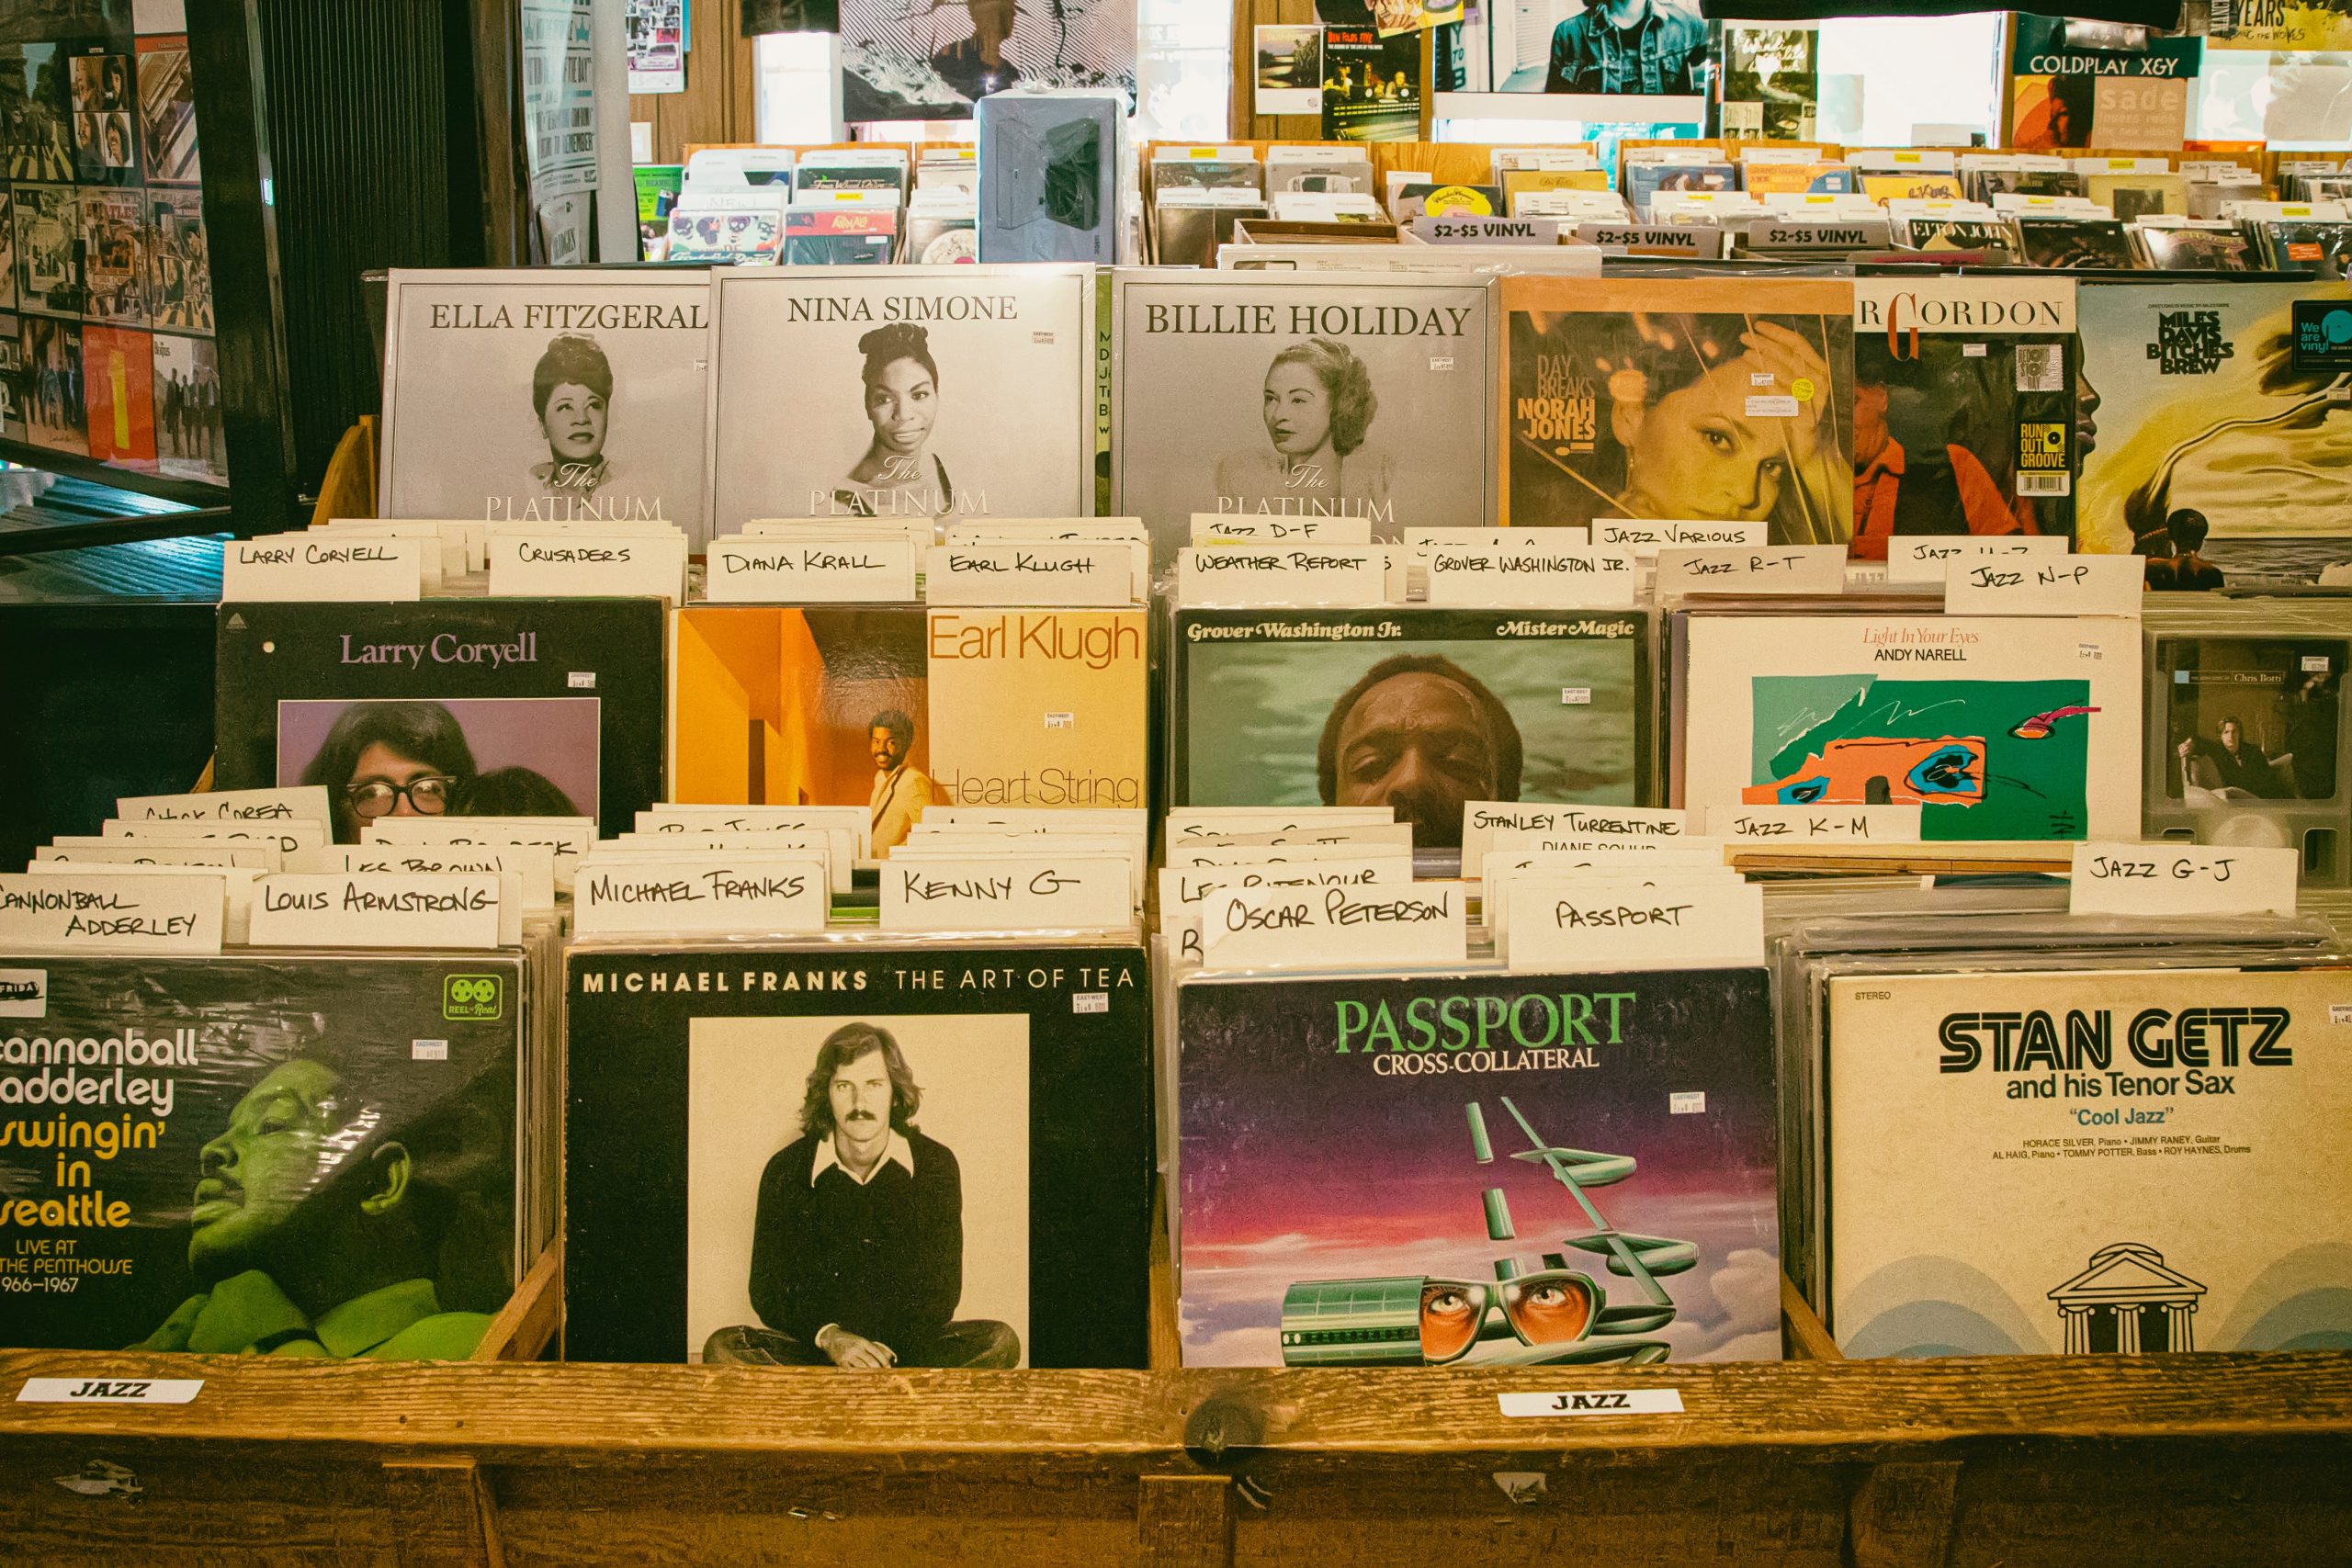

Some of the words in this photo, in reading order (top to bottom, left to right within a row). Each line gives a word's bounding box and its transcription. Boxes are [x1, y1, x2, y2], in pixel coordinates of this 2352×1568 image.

[2234, 0, 2285, 27] YEARS
[2030, 56, 2128, 74] COLDPLAY
[2139, 58, 2179, 75] X&Y
[2100, 86, 2179, 111] sade
[1434, 225, 1479, 238] $2-$5
[1484, 223, 1536, 237] VINYL
[1597, 231, 1640, 244] $2-$5
[1645, 231, 1696, 246] VINYL
[1770, 230, 1813, 243] $2-$5
[1817, 230, 1868, 243] VINYL
[1913, 222, 1967, 238] ELTON
[1969, 224, 2013, 239] JOHN
[430, 304, 514, 329] ELLA
[524, 304, 709, 329] FITZGERAL
[787, 298, 875, 322] NINA
[883, 296, 1018, 321] SIMONE
[1146, 304, 1276, 334] BILLIE
[1288, 306, 1471, 336] HOLIDAY
[2159, 311, 2221, 328] MILES
[1887, 291, 2064, 362] GORDON
[2158, 326, 2222, 344] DAVIS
[2301, 322, 2320, 333] We
[2301, 333, 2320, 342] are
[2146, 343, 2234, 359] BITCHES
[2301, 340, 2329, 354] vinyl
[1537, 355, 1571, 378] DAY
[2160, 357, 2222, 375] BREW
[1537, 377, 1595, 399] BREAKS
[1518, 399, 1596, 421] NORAH
[1524, 419, 1596, 441] JONES
[2021, 423, 2042, 438] RUN
[2021, 438, 2042, 452] OUT
[877, 455, 922, 481] The
[2021, 453, 2065, 468] GROOVE
[554, 462, 598, 488] The
[1285, 463, 1329, 489] The
[486, 495, 662, 521] PLATINUM
[808, 490, 991, 517] PLATINUM
[1217, 496, 1396, 524] PLATINUM
[1271, 522, 1318, 538] D-F
[1603, 527, 1661, 543] JAZZ
[1663, 524, 1747, 544] VARIOUS
[240, 547, 296, 565] LARRY
[305, 544, 399, 564] CORYELL
[519, 543, 632, 564] CRUSADERS
[723, 554, 794, 573] DIANA
[805, 551, 886, 571] KRALL
[950, 554, 1009, 572] EARL
[1014, 553, 1095, 574] KLUGH
[1195, 553, 1286, 572] WEATHER
[1287, 553, 1367, 572] REPORT
[1434, 555, 1495, 573] GROVER
[1497, 556, 1596, 574] WASHINGTON
[1684, 559, 1738, 576] JAZZ
[1750, 556, 1806, 570] R-T
[1970, 567, 2025, 588] JAZZ
[2038, 567, 2089, 585] N-P
[1187, 623, 1255, 643] Grover
[1256, 622, 1374, 641] Washington
[1375, 621, 1402, 639] Jr.
[1497, 624, 1568, 638] Mister
[1567, 622, 1634, 638] Magic
[1862, 627, 1898, 646] Light
[1899, 628, 1915, 643] In
[1916, 628, 1948, 643] Your
[1949, 629, 1979, 646] Eyes
[340, 635, 425, 669] Larry
[431, 631, 538, 668] Coryell
[928, 615, 1006, 660] Earl
[1018, 615, 1140, 670] Klugh
[1874, 649, 1912, 662] ANDY
[1915, 649, 1967, 661] NARELL
[2233, 673, 2257, 683] Chris
[2258, 672, 2282, 683] Botti
[932, 768, 1031, 805] Heart
[1039, 768, 1139, 810] String
[1474, 810, 1555, 829] STANLEY
[1562, 812, 1680, 836] TURRENTINE
[1734, 817, 1794, 835] JAZZ
[1809, 817, 1870, 840] K-M
[2089, 856, 2160, 878] JAZZ
[2171, 858, 2240, 883] G-J
[265, 885, 330, 912] LOUIS
[343, 882, 499, 913] ARMSTRONG
[591, 874, 707, 906] MICHAEL
[702, 870, 805, 901] FRANKS
[903, 869, 1012, 904] KENNY
[1029, 869, 1081, 896] G
[1226, 897, 1316, 931] OSCAR
[1325, 887, 1449, 926] PETERSON
[1555, 900, 1695, 929] PASSPORT
[65, 913, 198, 938] ADDERLEY
[582, 973, 729, 993] MICHAEL
[743, 970, 867, 991] FRANKS
[895, 970, 945, 989] THE
[959, 969, 1015, 988] ART
[1027, 968, 1065, 988] OF
[1080, 968, 1134, 987] TEA
[1855, 991, 1892, 1000] STEREO
[448, 1006, 469, 1014] REEL
[1335, 992, 1637, 1054] PASSPORT
[1939, 1010, 2111, 1073] STAN
[2128, 1007, 2293, 1069] GETZ
[1373, 1047, 1600, 1076] CROSS-COLLATERAL
[0, 1066, 174, 1117] adderley
[2007, 1075, 2057, 1100] and
[2064, 1073, 2103, 1098] his
[2106, 1071, 2181, 1097] Tenor
[2186, 1070, 2235, 1095] Sax
[2070, 1108, 2120, 1126] “Cool
[2124, 1107, 2175, 1124] Jazz”
[0, 1112, 165, 1160] swingin’
[2023, 1139, 2061, 1148] HORACE
[2098, 1137, 2122, 1146] Piano
[2130, 1136, 2158, 1145] JIMMY
[2195, 1134, 2221, 1144] Guitar
[1993, 1152, 2004, 1160] AL
[2006, 1151, 2030, 1160] HAIG,
[2032, 1150, 2055, 1159] Piano
[2064, 1148, 2096, 1157] TOMMY
[2136, 1146, 2157, 1156] Bass
[2164, 1145, 2183, 1155] ROY
[2224, 1145, 2251, 1154] Drums
[56, 1152, 90, 1188] in
[0, 1190, 130, 1228] seattle
[17, 1240, 50, 1255] LIVE
[56, 1239, 77, 1255] AT
[0, 1258, 28, 1273] THE
[34, 1258, 133, 1275] PENTHOUSE
[0, 1277, 79, 1292] 966–1967
[70, 1382, 152, 1398] JAZZ
[1551, 1393, 1632, 1411] JAZZ
